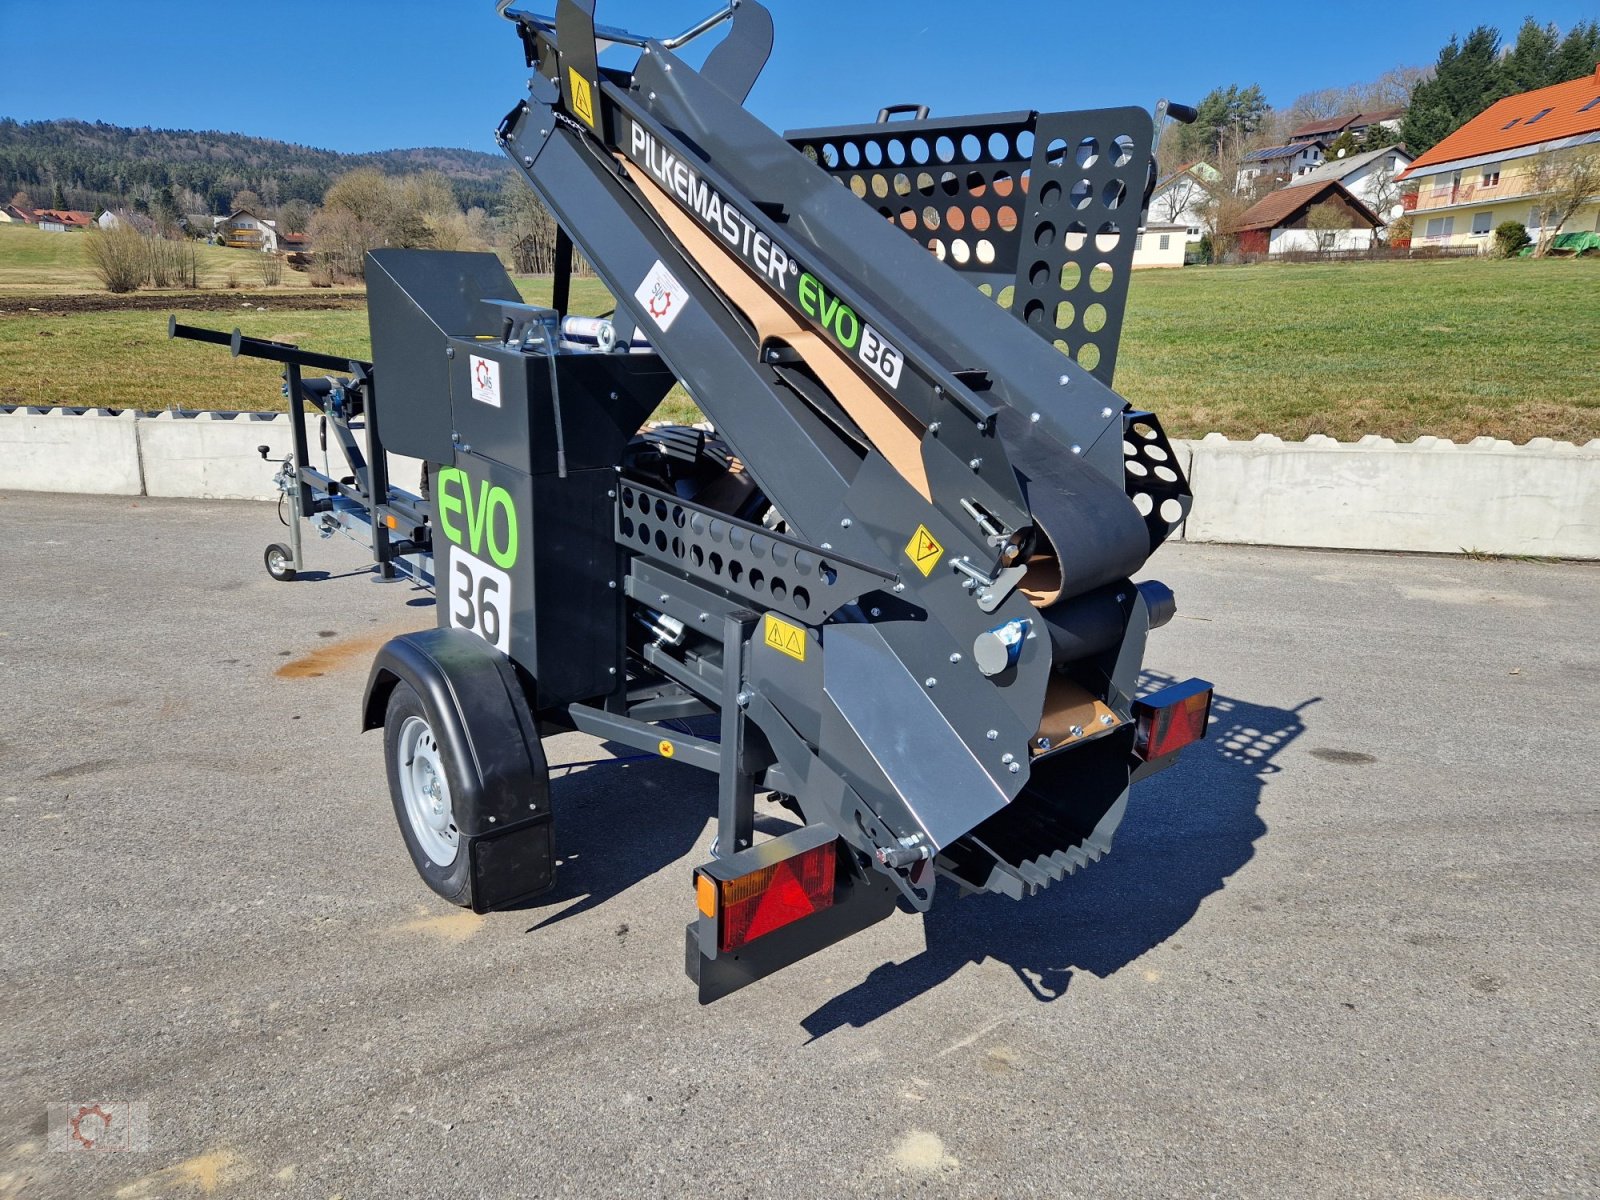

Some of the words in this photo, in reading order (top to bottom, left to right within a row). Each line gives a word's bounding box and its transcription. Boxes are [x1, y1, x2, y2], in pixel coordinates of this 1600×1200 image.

[798, 272, 859, 349] EVO
[863, 332, 896, 378] 36
[437, 467, 518, 569] EVO
[455, 561, 499, 646] 36
